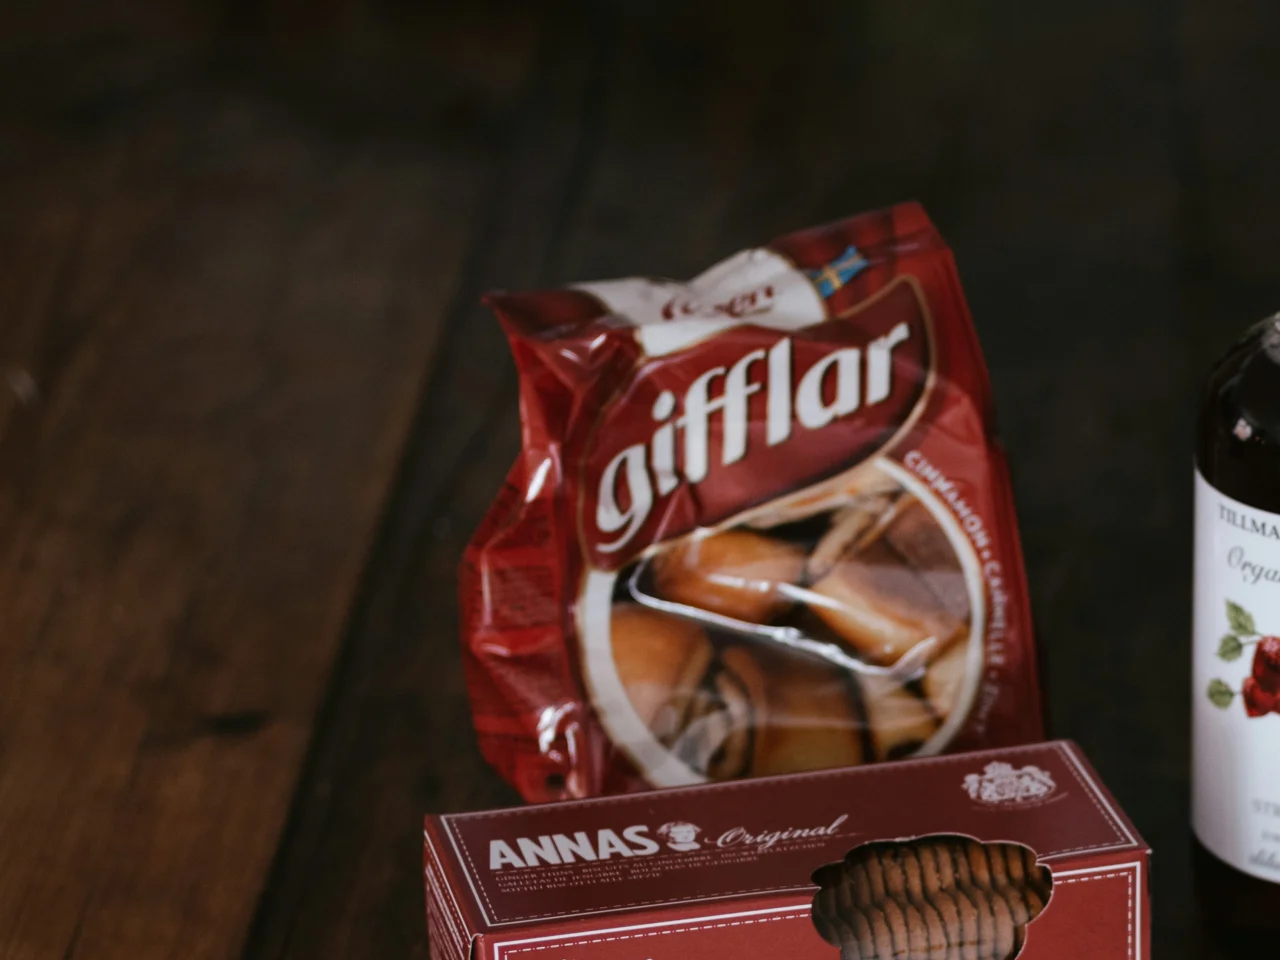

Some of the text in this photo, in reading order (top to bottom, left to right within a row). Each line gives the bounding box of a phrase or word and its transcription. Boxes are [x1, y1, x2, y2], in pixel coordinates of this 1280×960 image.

[596, 320, 911, 553] gifflar
[489, 814, 849, 870] ANNAS Original
